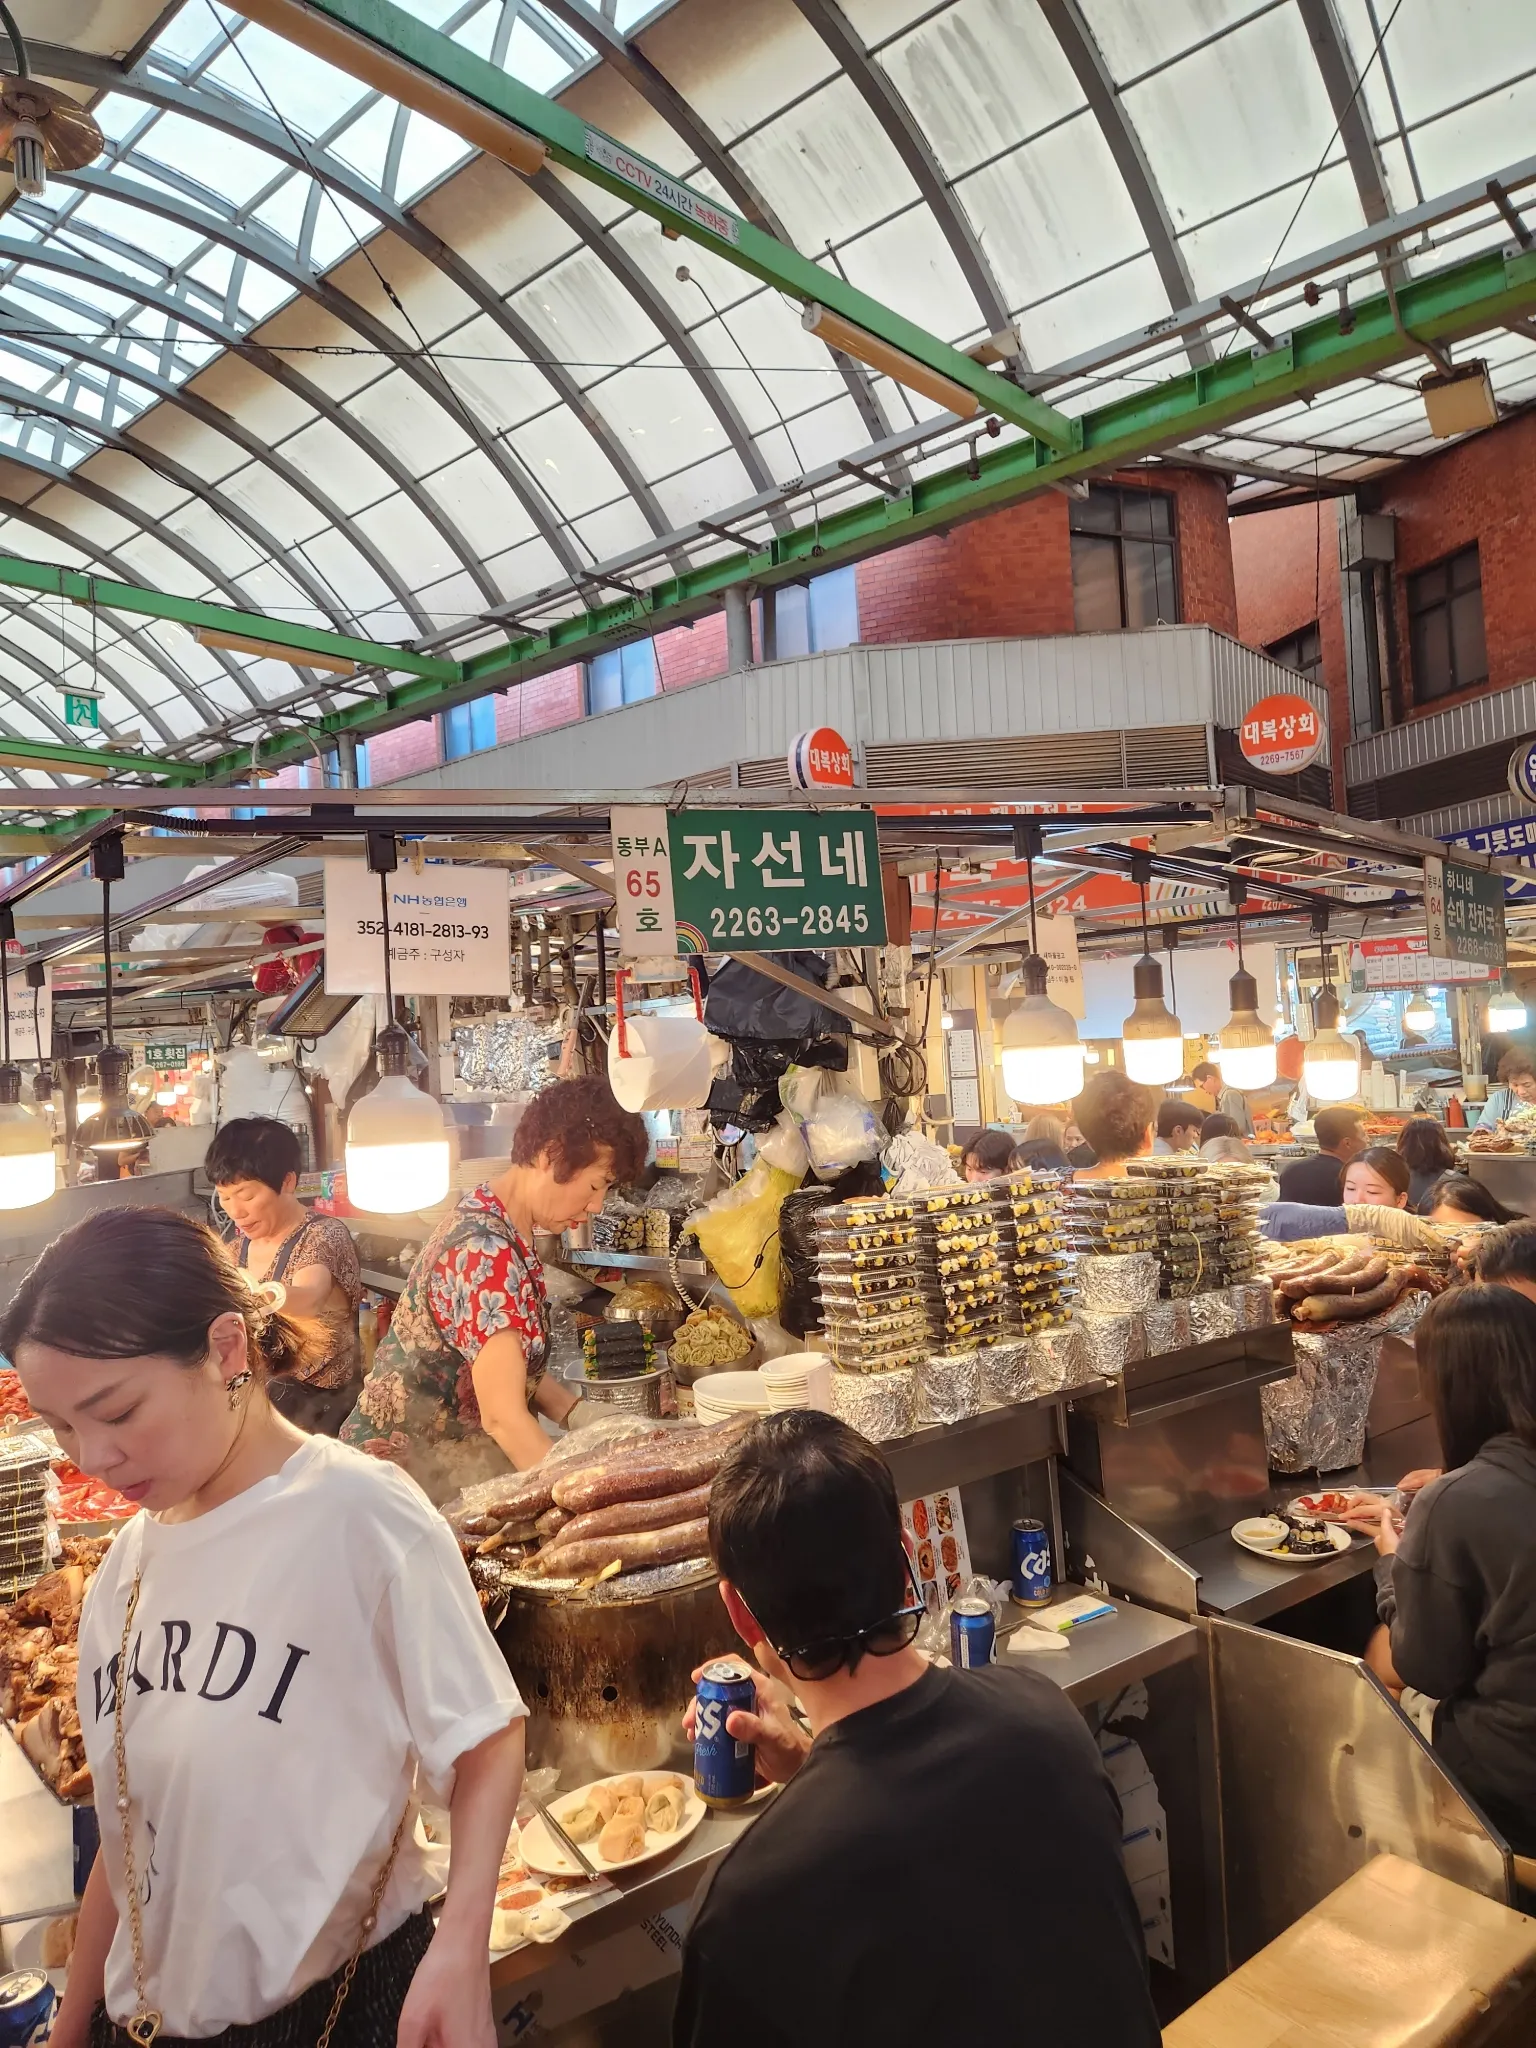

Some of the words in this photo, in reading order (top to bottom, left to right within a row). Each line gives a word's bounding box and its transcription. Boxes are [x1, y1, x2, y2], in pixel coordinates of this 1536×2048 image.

[615, 156, 652, 188] CCTV
[655, 179, 693, 215] 24시간
[695, 203, 729, 236] 녹화중
[1243, 712, 1315, 745] 대복상회
[809, 748, 851, 777] 대복상회
[616, 836, 668, 858] 동부A
[682, 830, 868, 890] 자선네
[626, 869, 661, 898] 65
[1446, 870, 1474, 897] 하니네
[393, 893, 468, 908] NH농협은행
[1430, 896, 1442, 917] 64
[1446, 896, 1466, 931] 순대
[356, 920, 490, 940] 352-4181-2813-93
[635, 907, 663, 932] 호
[710, 904, 869, 938] 2263-2845
[1433, 923, 1442, 941] 호
[429, 948, 466, 963] 구성자
[640, 1918, 668, 1953] STEEL
